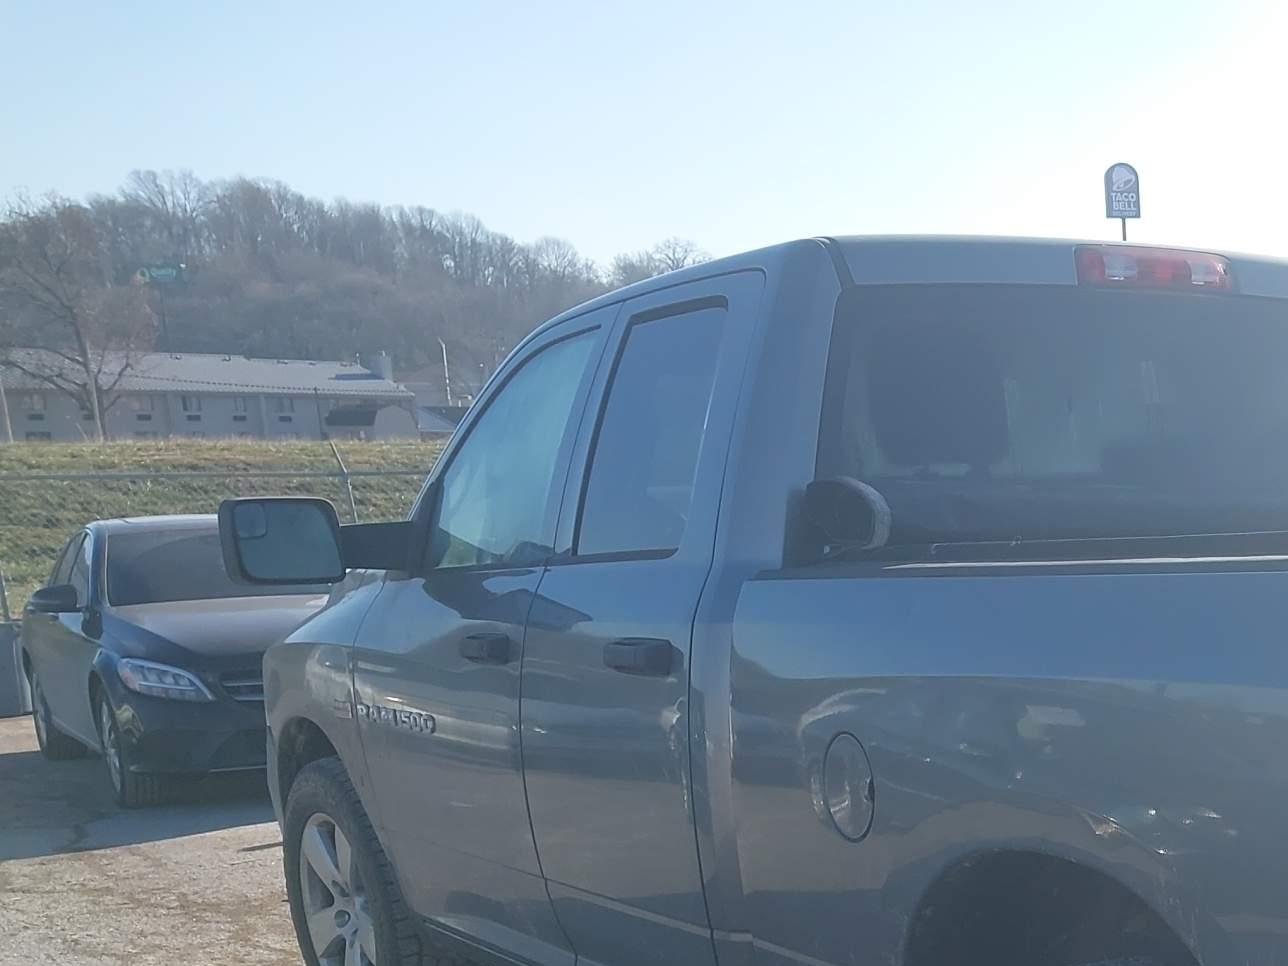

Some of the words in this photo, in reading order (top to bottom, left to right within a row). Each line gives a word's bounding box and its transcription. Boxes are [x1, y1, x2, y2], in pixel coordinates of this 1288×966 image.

[1111, 192, 1136, 202] TACO
[1112, 201, 1137, 211] BELL
[356, 703, 394, 723] RAM
[393, 708, 437, 734] 1500
